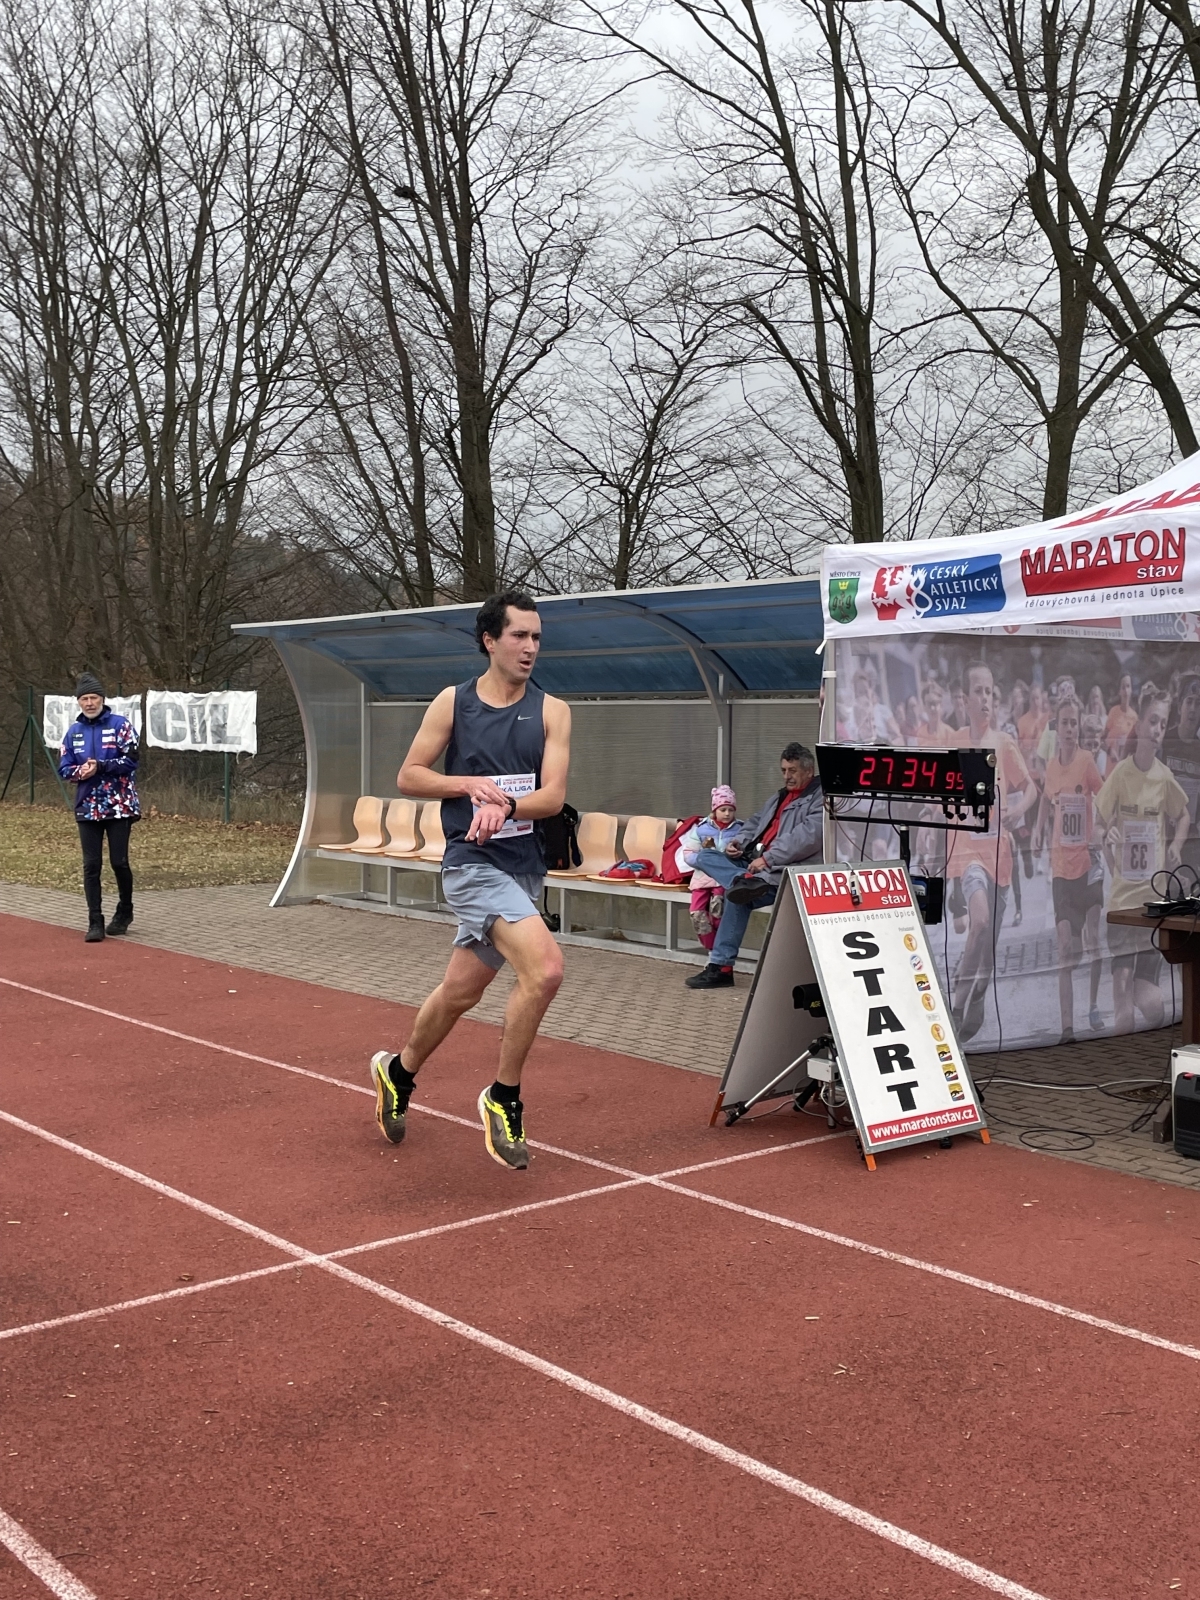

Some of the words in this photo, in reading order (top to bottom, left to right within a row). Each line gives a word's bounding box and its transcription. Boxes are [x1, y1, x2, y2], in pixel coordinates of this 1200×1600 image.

[1020, 527, 1185, 576] MARATON
[929, 561, 969, 580] ČESKÝ
[1137, 564, 1179, 579] stav
[930, 573, 998, 596] ATLETICKÝ
[935, 596, 967, 612] SVAZ
[1025, 594, 1096, 608] tělovýchovná
[1101, 589, 1144, 603] jednota
[1150, 586, 1184, 598] Úpice
[859, 757, 894, 786] 27
[901, 758, 937, 788] 34
[881, 894, 907, 905] stav
[810, 915, 860, 926] tělovýchovná
[863, 912, 891, 923] jednota
[894, 910, 915, 919] Úpice
[842, 931, 919, 1112] START
[872, 1109, 975, 1138] www.maratonstav.cz
